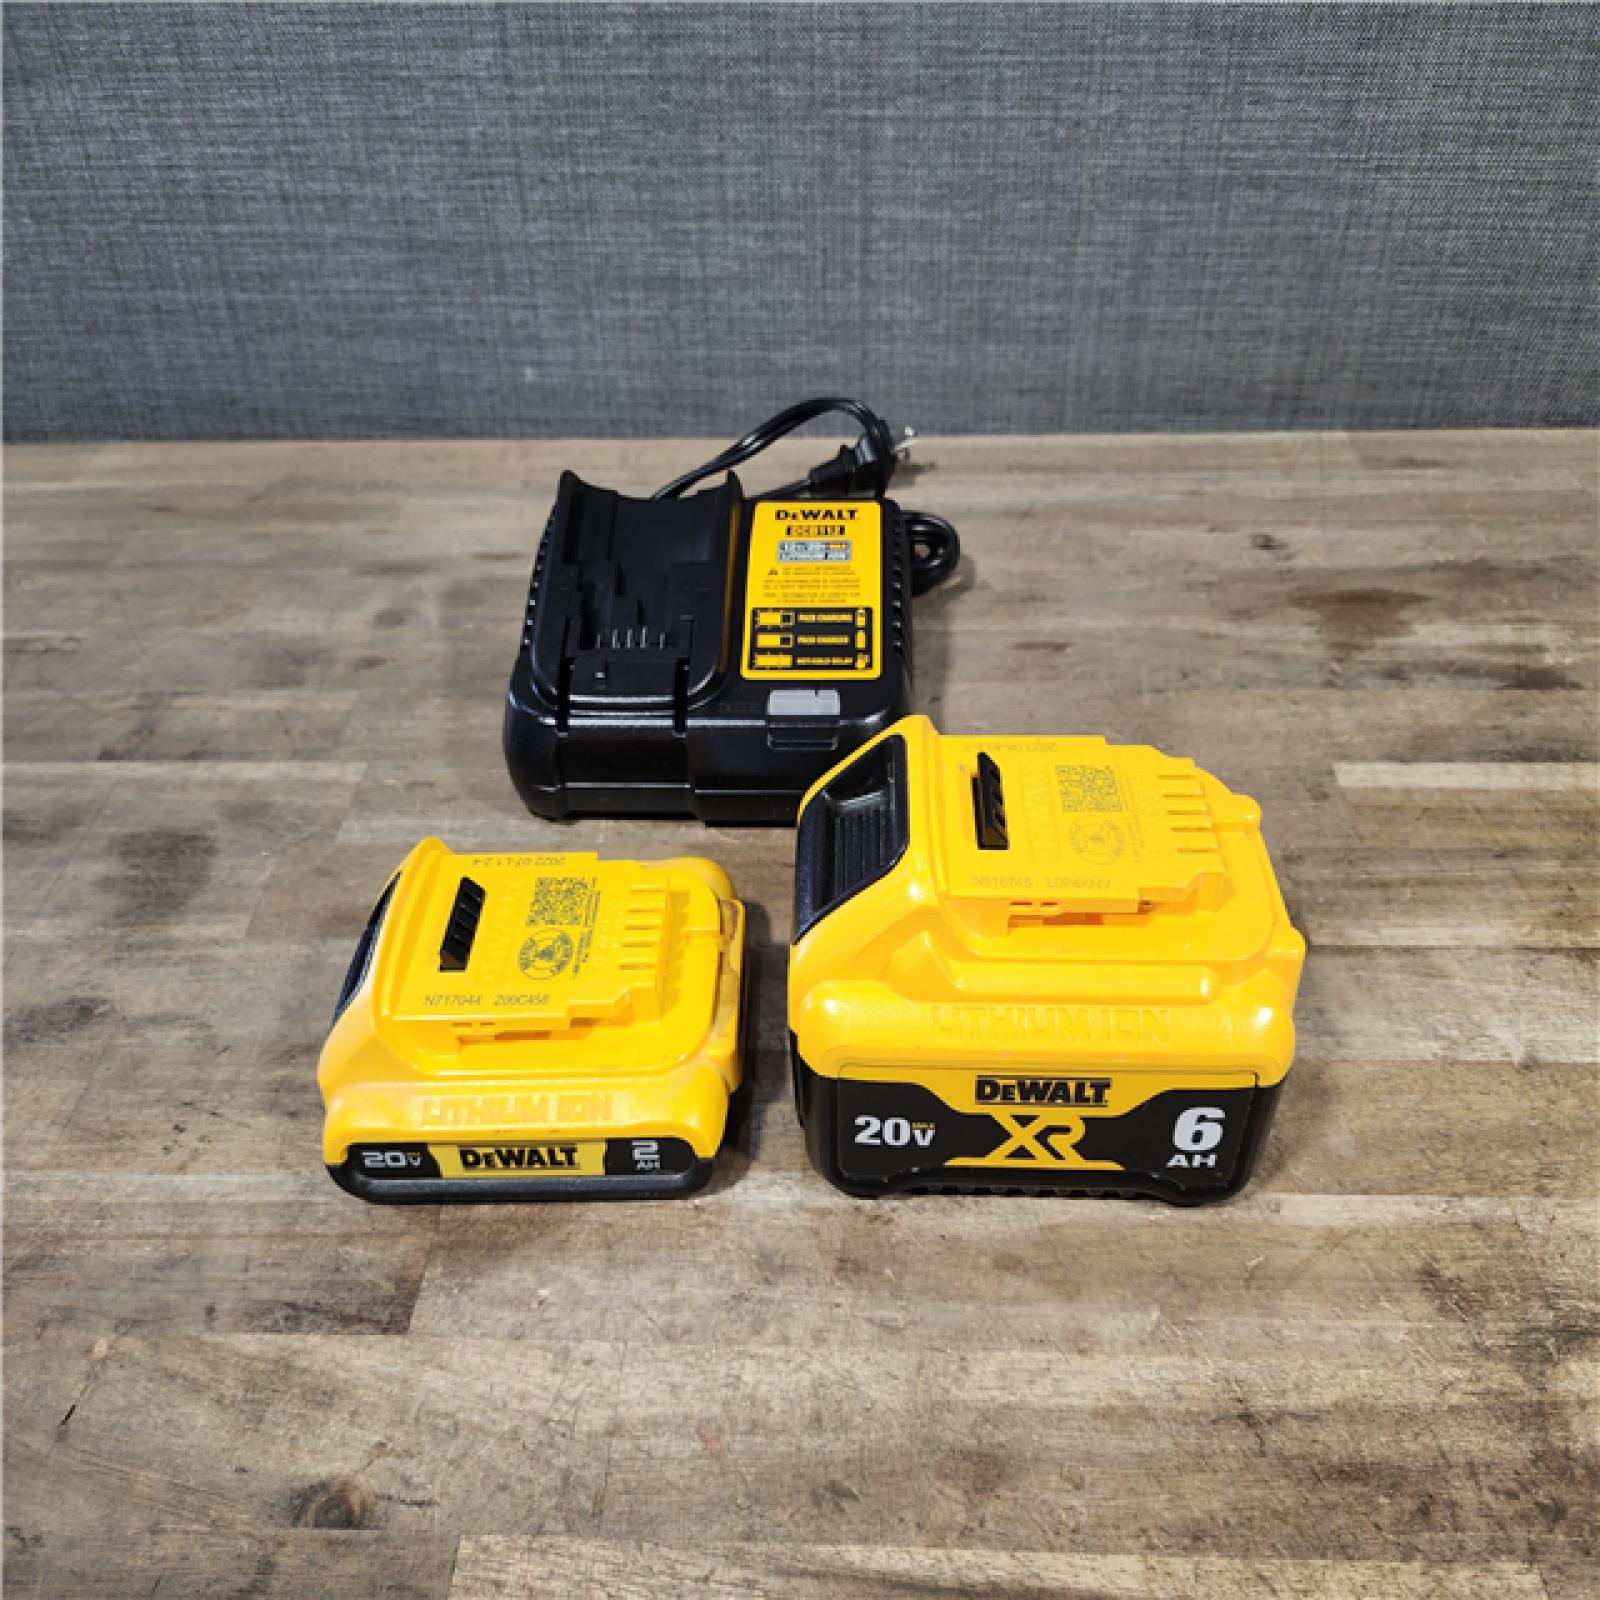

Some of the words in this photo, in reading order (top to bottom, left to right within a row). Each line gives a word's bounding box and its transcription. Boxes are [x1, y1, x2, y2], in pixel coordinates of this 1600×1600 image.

[775, 509, 858, 520] DEWALT
[932, 1005, 1090, 1041] LITHIUM
[1101, 1009, 1172, 1045] ION
[976, 1078, 1110, 1103] DEWALT
[421, 1095, 551, 1126] LITHIUM
[556, 1092, 613, 1123] ION
[985, 1114, 1086, 1161] XR
[1173, 1107, 1226, 1151] 6
[459, 1146, 578, 1168] DEWALT
[632, 1140, 660, 1160] 2
[1166, 1154, 1217, 1168] AH
